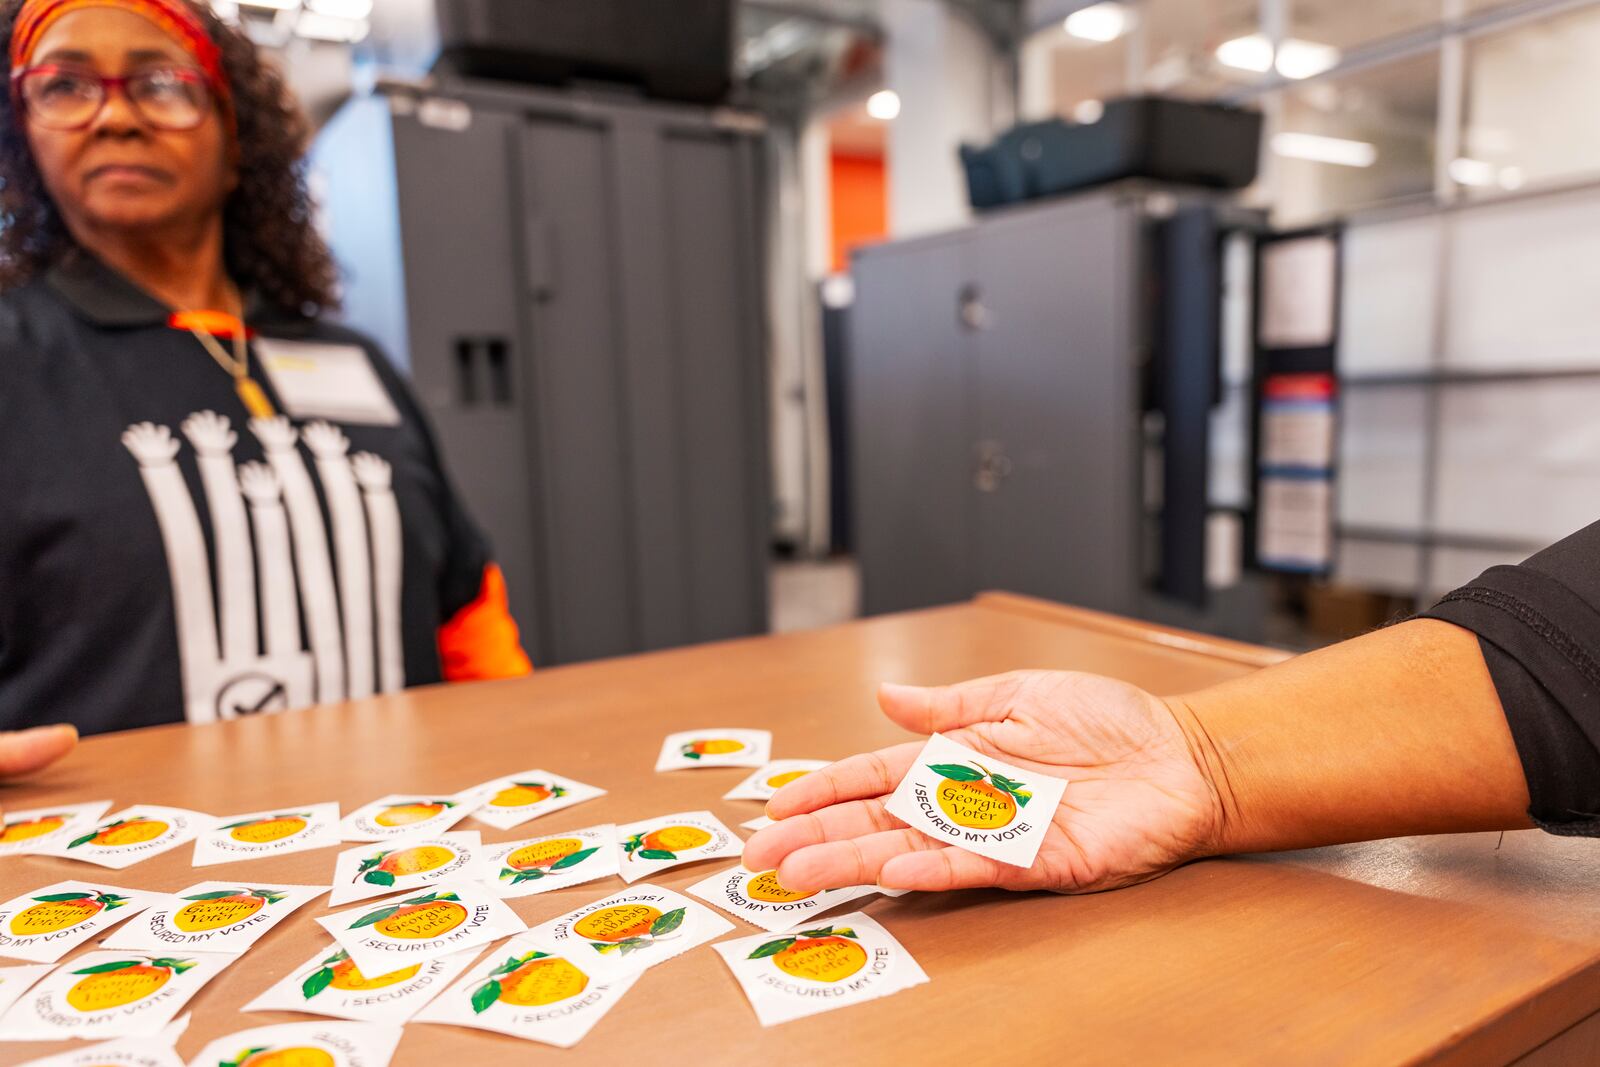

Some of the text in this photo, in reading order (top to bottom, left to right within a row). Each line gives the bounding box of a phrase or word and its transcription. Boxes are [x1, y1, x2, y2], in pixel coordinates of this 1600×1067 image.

[943, 787, 1009, 812] Georgia
[961, 783, 981, 795] I'm
[914, 788, 961, 837] SECURED
[965, 832, 988, 843] MY
[991, 822, 1033, 842] VOTE!
[951, 803, 997, 821] Voter
[725, 875, 747, 906] SECURED
[744, 902, 769, 912] MY
[772, 900, 818, 912] VOTE!
[150, 914, 186, 943] SECURED
[187, 932, 215, 943] MY
[220, 914, 270, 936] VOTE!
[366, 940, 445, 952] SECURED
[448, 928, 471, 942] MY
[467, 904, 489, 927] VOTE!
[385, 904, 450, 933] Georgia
[407, 912, 455, 934] Voter
[589, 908, 629, 929] Voter
[596, 906, 650, 938] Georgia
[11, 922, 96, 947] MY VOTE!
[783, 942, 848, 970] Georgia
[804, 956, 851, 976] Voter
[353, 975, 433, 1007] SECURED
[764, 977, 845, 997] SECURED
[524, 992, 602, 1022] SECURED
